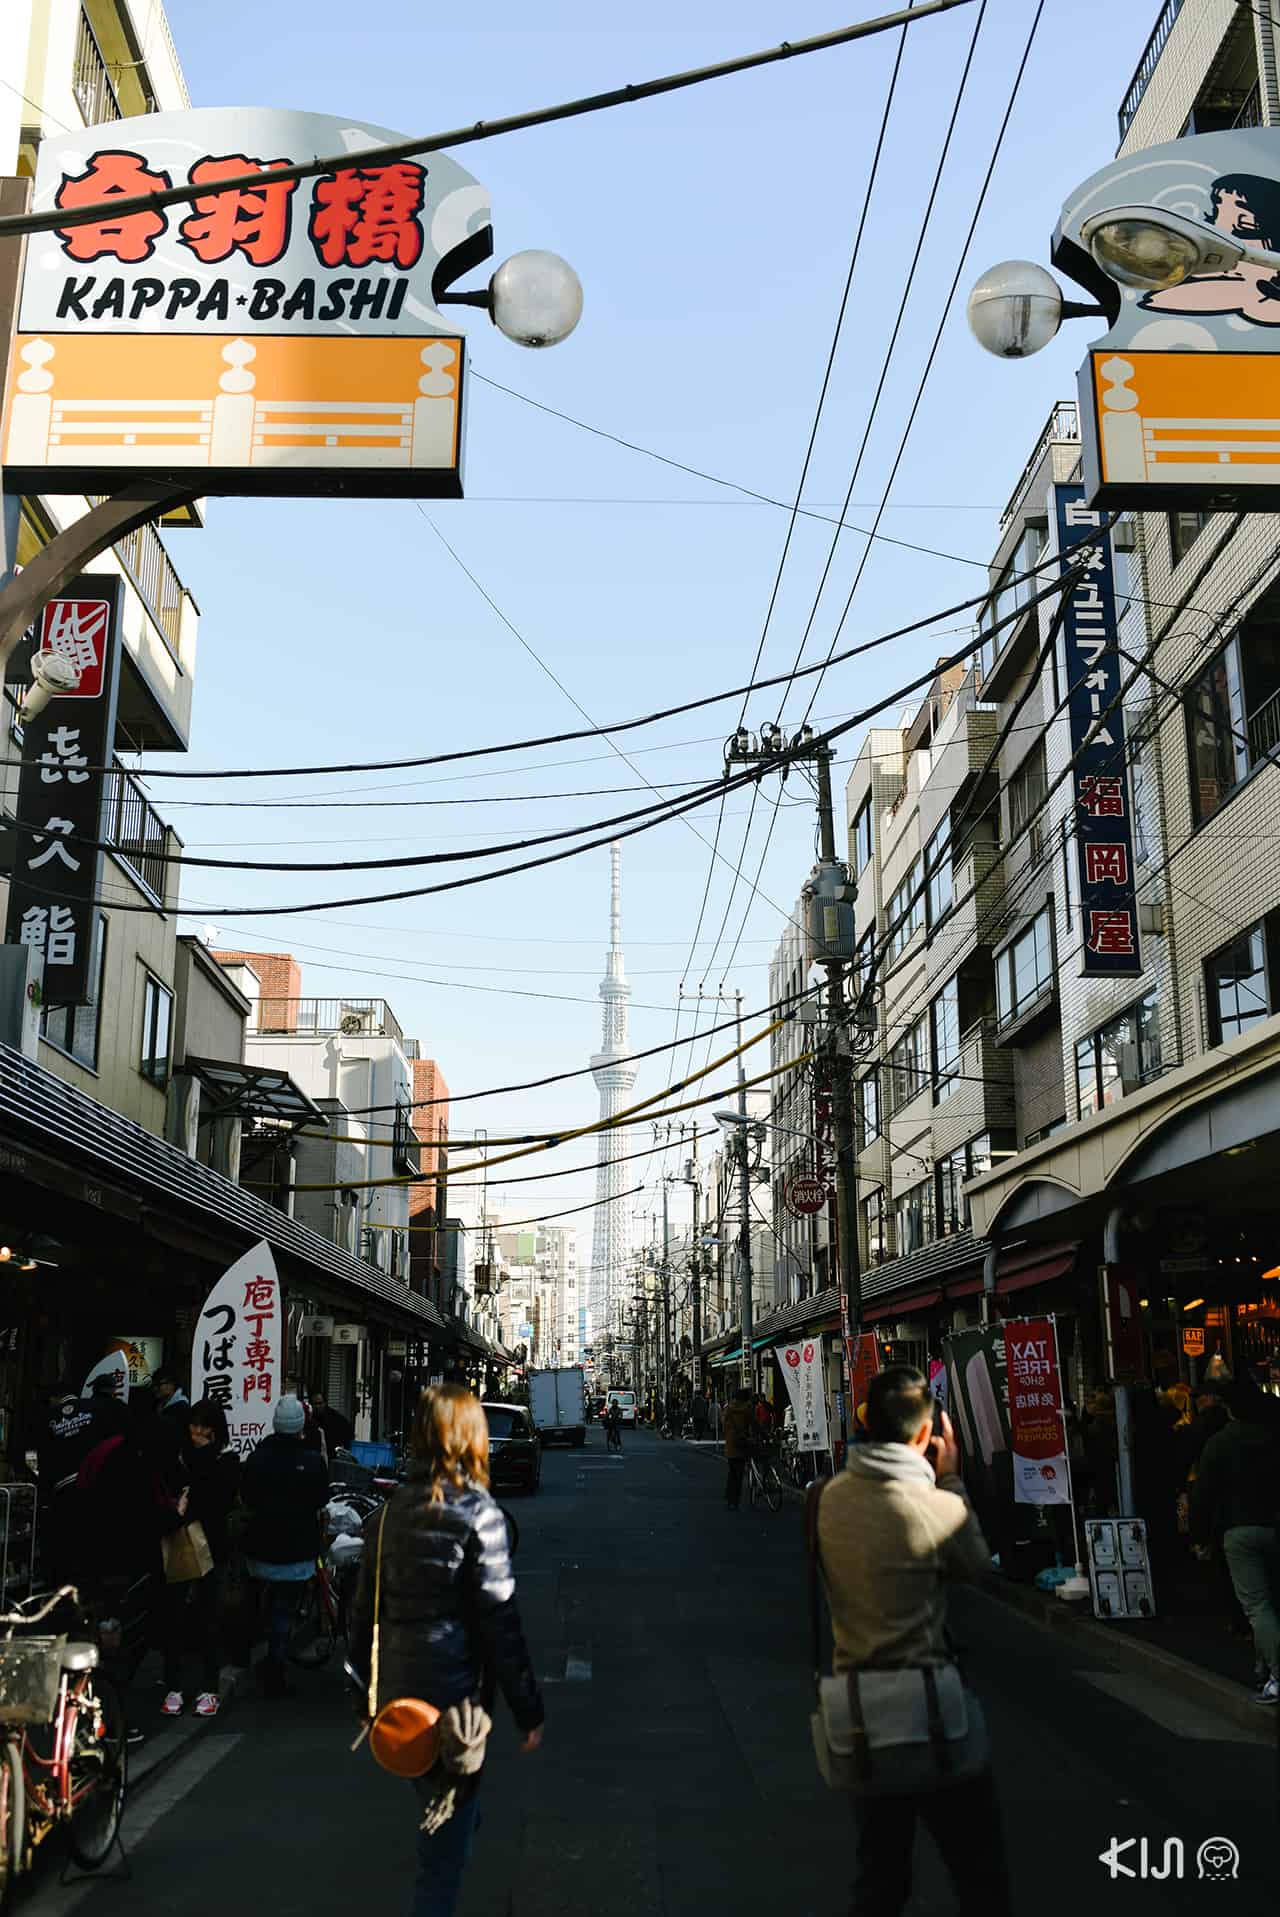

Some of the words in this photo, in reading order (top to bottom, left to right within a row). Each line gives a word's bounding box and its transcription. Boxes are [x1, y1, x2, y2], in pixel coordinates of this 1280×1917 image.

[54, 149, 428, 269] 合羽橋
[1078, 775, 1135, 955] 福岡屋
[793, 1188, 825, 1205] 消火栓
[202, 1303, 237, 1411] つば屋
